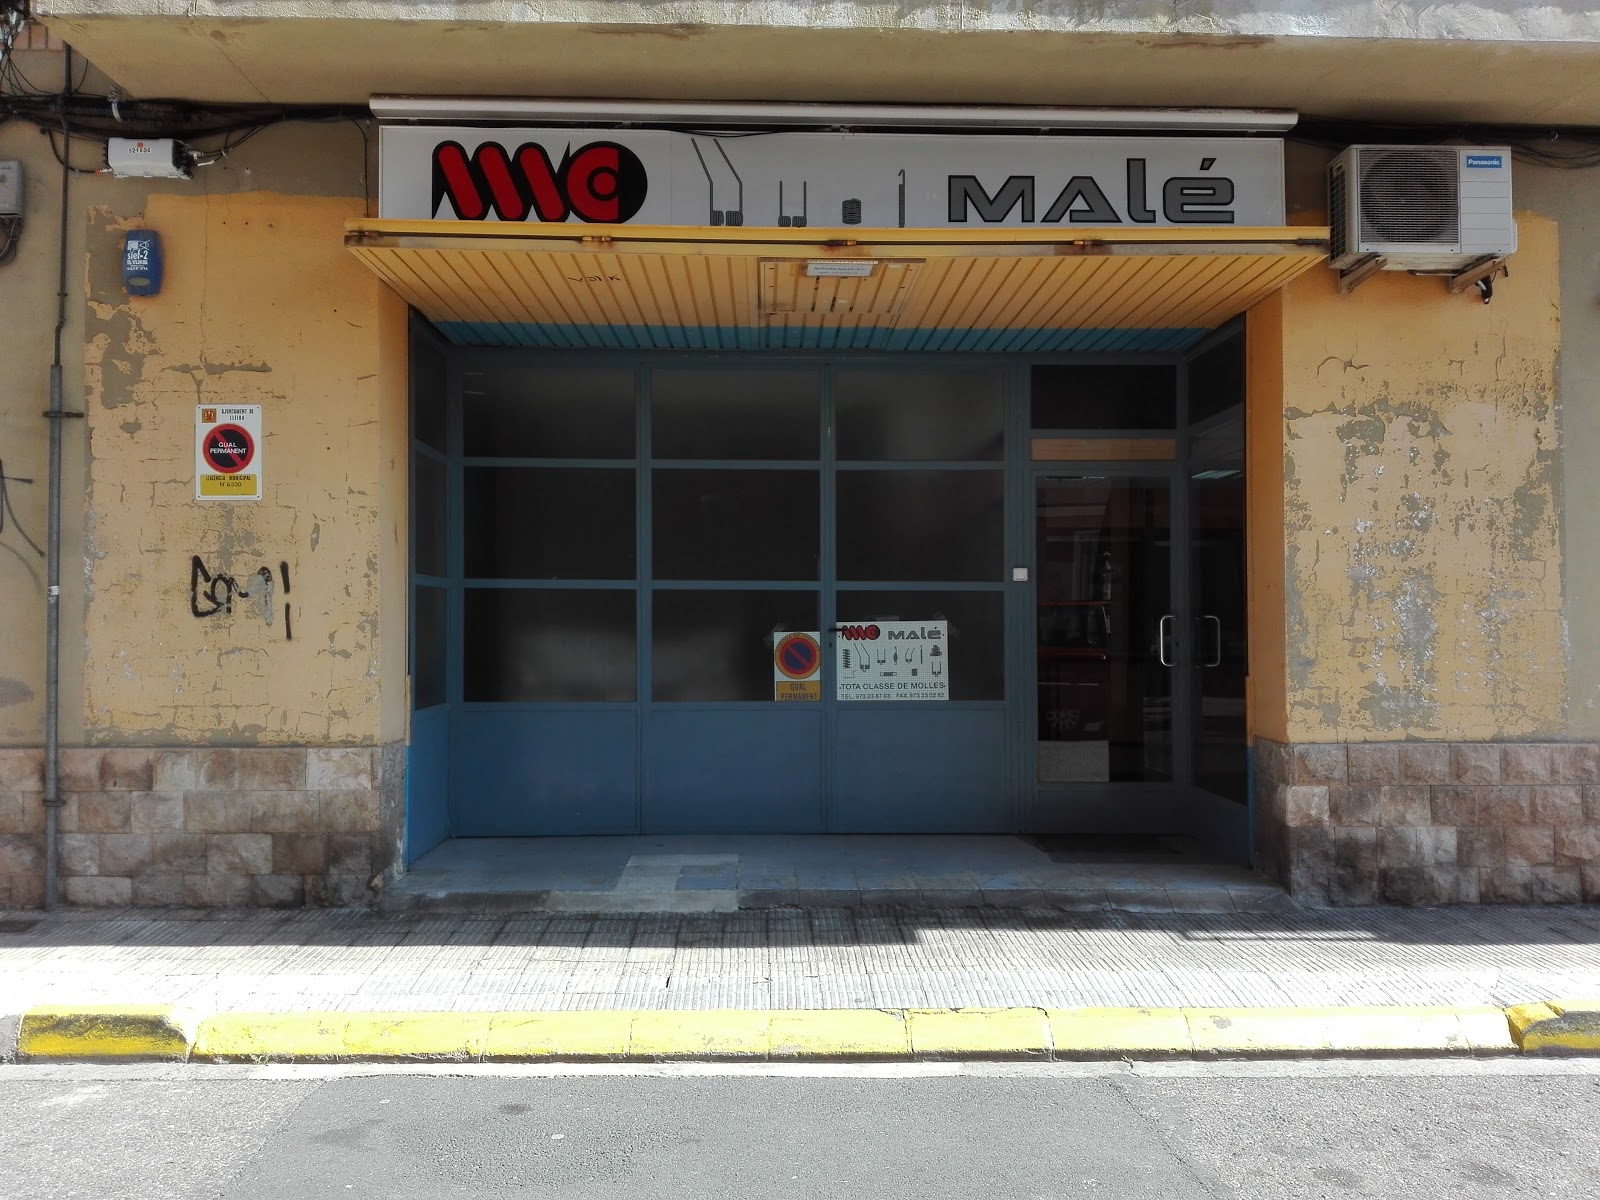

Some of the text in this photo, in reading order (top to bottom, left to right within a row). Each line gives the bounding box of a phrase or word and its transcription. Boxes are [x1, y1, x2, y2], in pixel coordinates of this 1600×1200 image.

[790, 682, 807, 691] GUAL
[863, 682, 895, 690] CLASSE
[898, 682, 908, 690] DE
[911, 681, 943, 689] MOLLES
[781, 692, 817, 701] PERMANENT
